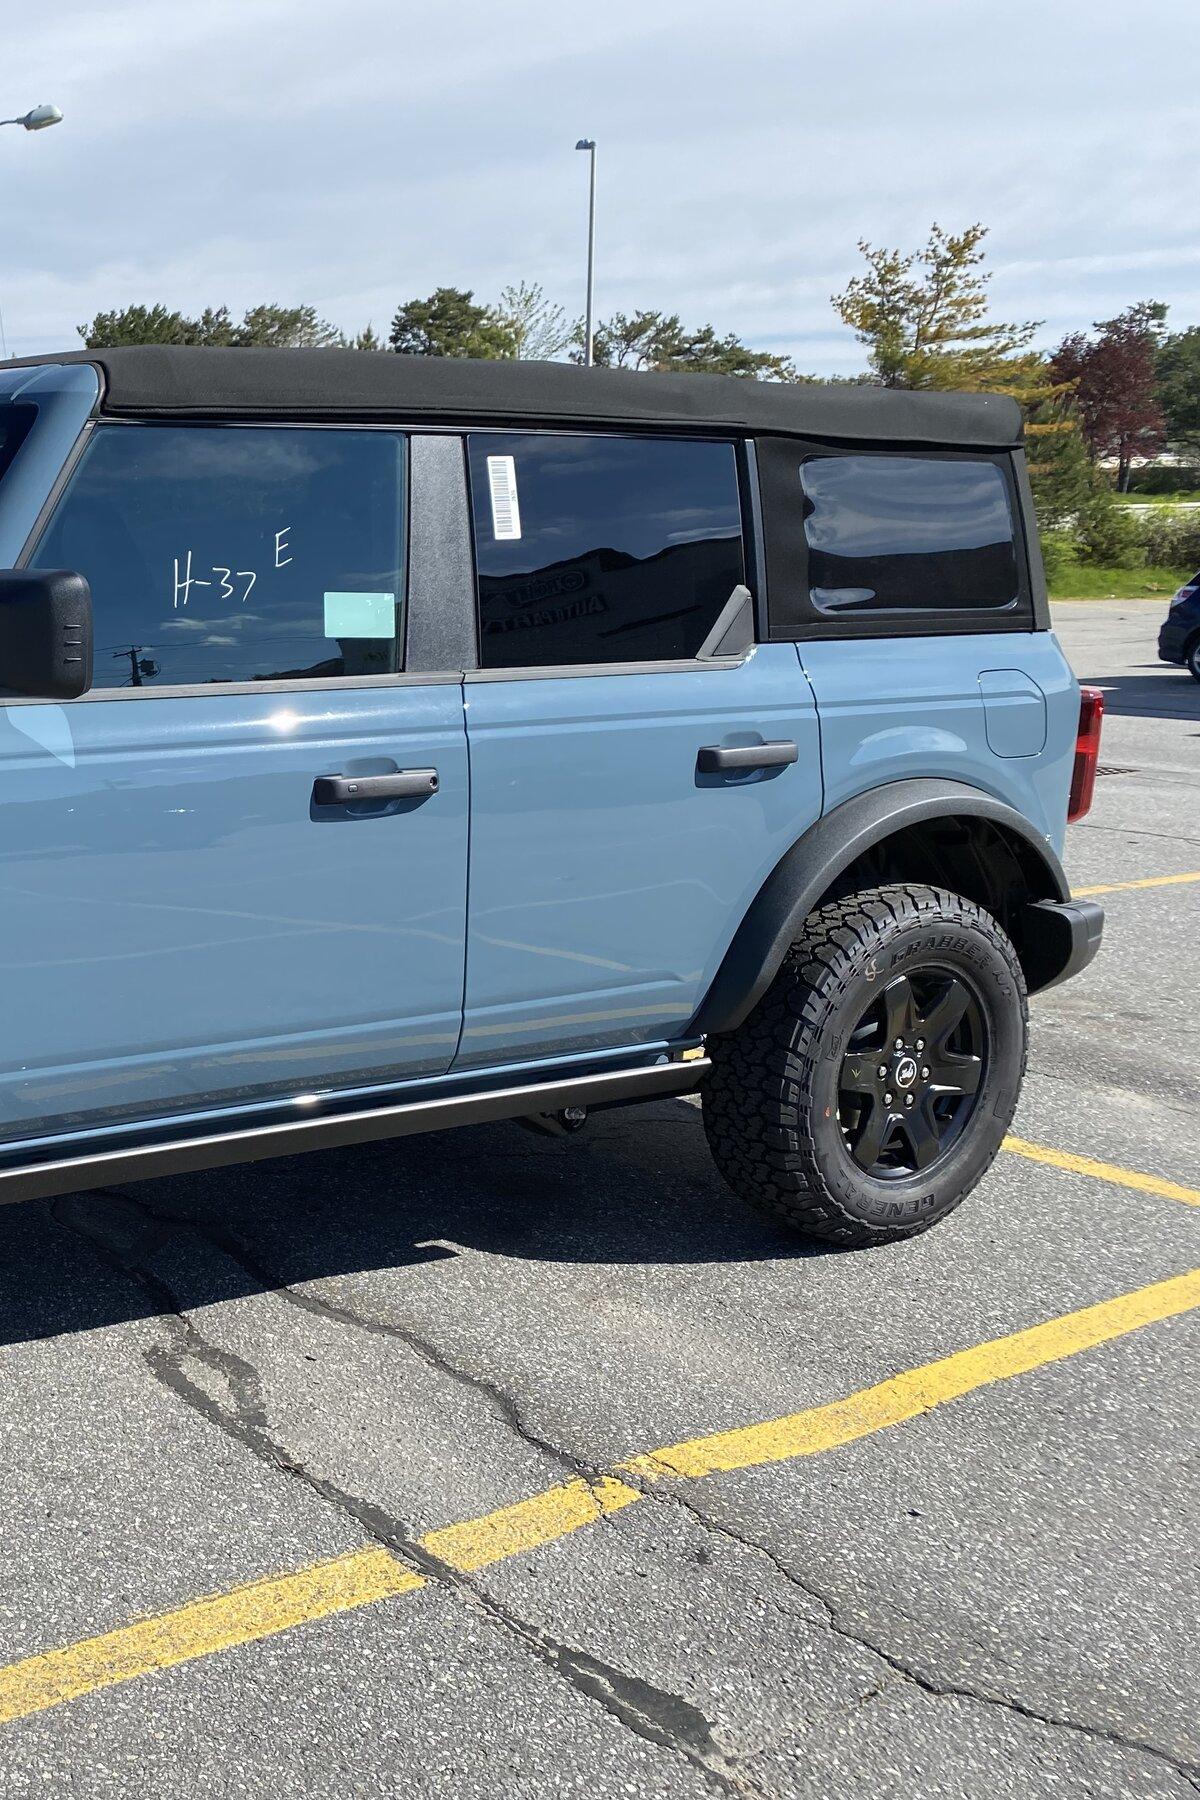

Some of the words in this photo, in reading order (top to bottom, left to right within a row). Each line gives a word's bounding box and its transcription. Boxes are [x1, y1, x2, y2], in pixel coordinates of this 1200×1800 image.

[173, 550, 257, 608] H-37
[274, 526, 293, 568] E
[890, 934, 993, 970] GRABBER
[836, 1169, 935, 1218] GENERAL
